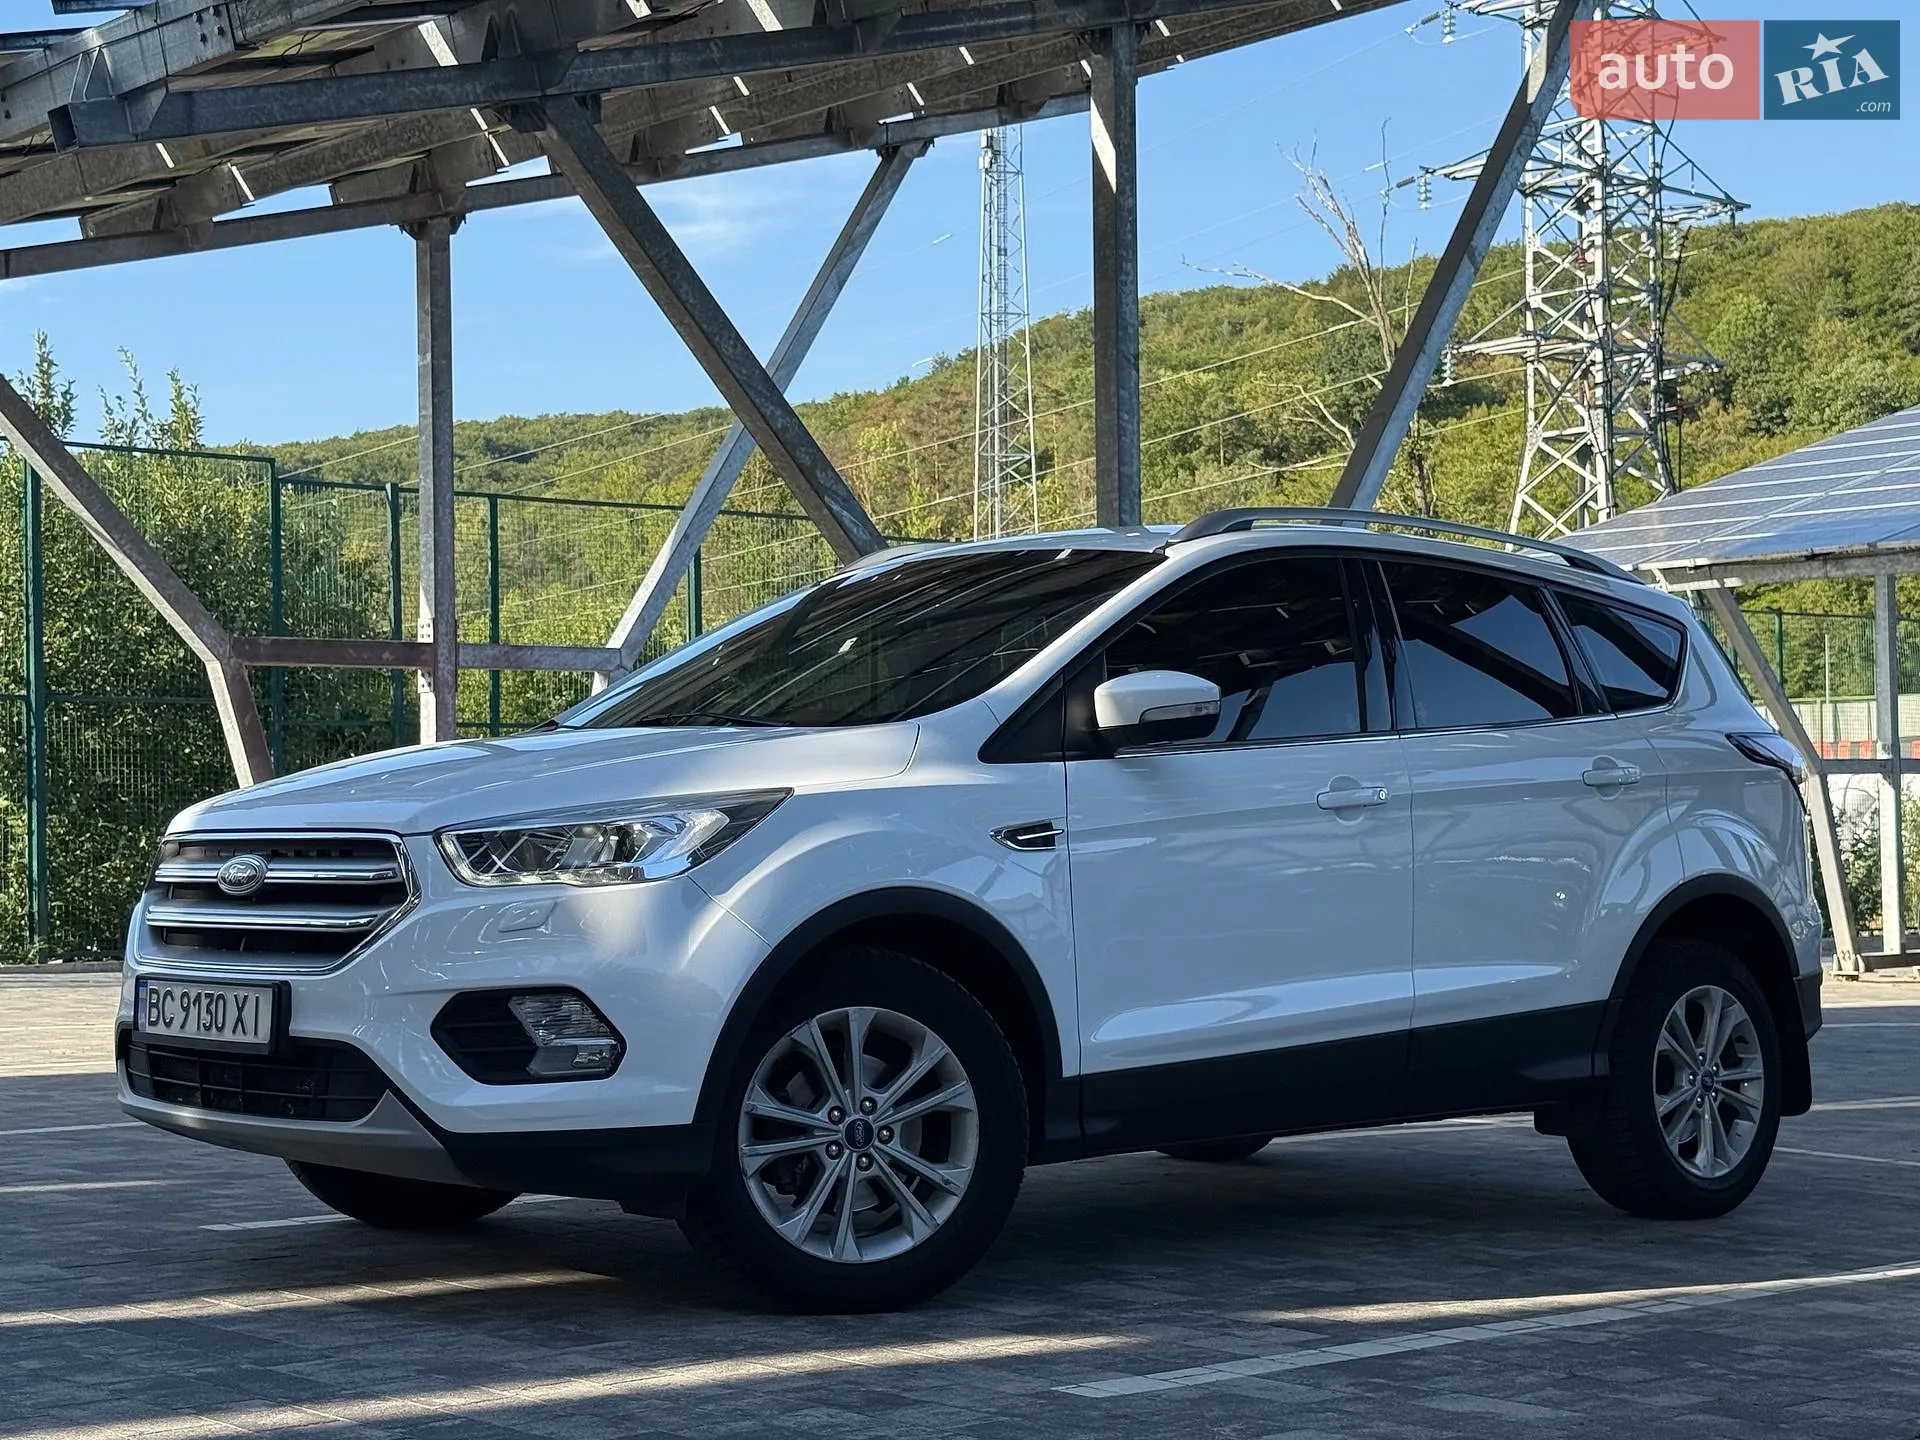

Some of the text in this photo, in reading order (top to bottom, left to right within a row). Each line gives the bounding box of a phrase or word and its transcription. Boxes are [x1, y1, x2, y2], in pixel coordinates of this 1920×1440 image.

[226, 864, 252, 883] Ford
[148, 985, 260, 1038] BC 9130 XI
